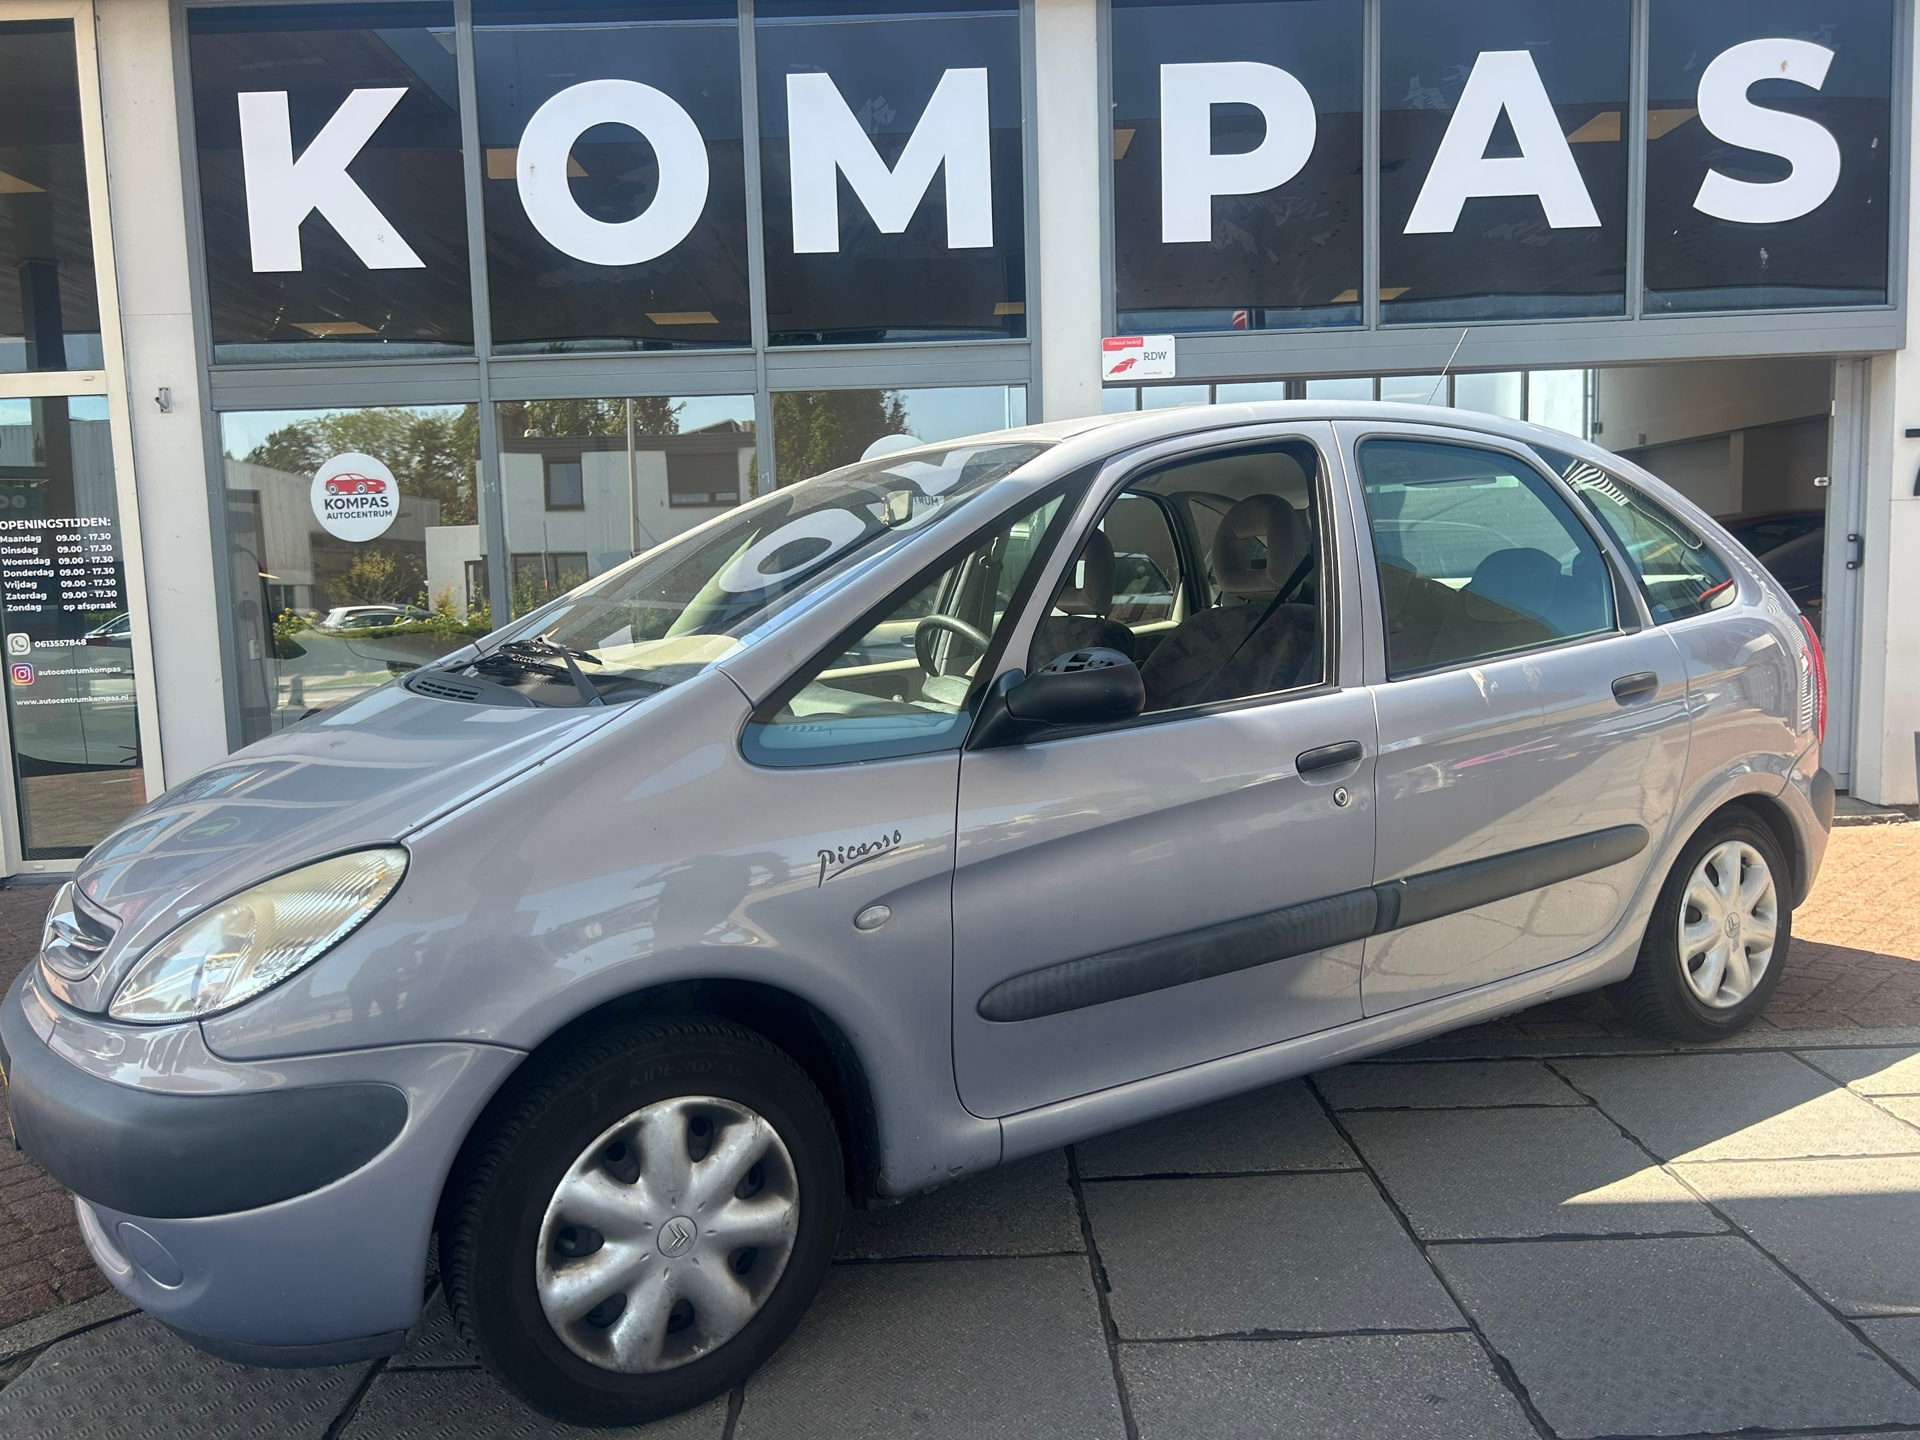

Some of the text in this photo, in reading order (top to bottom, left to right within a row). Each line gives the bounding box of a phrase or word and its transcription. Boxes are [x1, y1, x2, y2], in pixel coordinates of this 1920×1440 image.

[237, 37, 1842, 273] KOMPAS
[1143, 351, 1167, 361] RDW
[324, 496, 389, 510] KOMPAS
[326, 510, 393, 520] AUTOCENTRUM
[0, 517, 111, 531] OPENINGSTIJDEN:
[0, 534, 42, 543] Maandag
[55, 534, 81, 542] 09.00
[88, 533, 111, 541] 17.30
[1, 546, 39, 555] Dinsdag
[57, 545, 82, 553] 09.00
[89, 544, 112, 552] 17.30
[2, 557, 51, 567] Woensdag
[58, 557, 84, 565] 09.00
[3, 569, 54, 578] Donderdag
[59, 568, 85, 576] 09.00
[92, 567, 115, 575] 17.30
[4, 581, 37, 590] Vrijdag
[60, 580, 86, 588] 09.00
[5, 592, 47, 601] Zaterdag
[62, 591, 87, 599] 09.00
[94, 590, 117, 598] 17.30
[7, 601, 117, 612] Zondag op afspraak
[34, 639, 87, 648] 0613557848
[38, 666, 121, 676] autocentrumkompas
[16, 694, 129, 706] www.autocentrumkompas.nl
